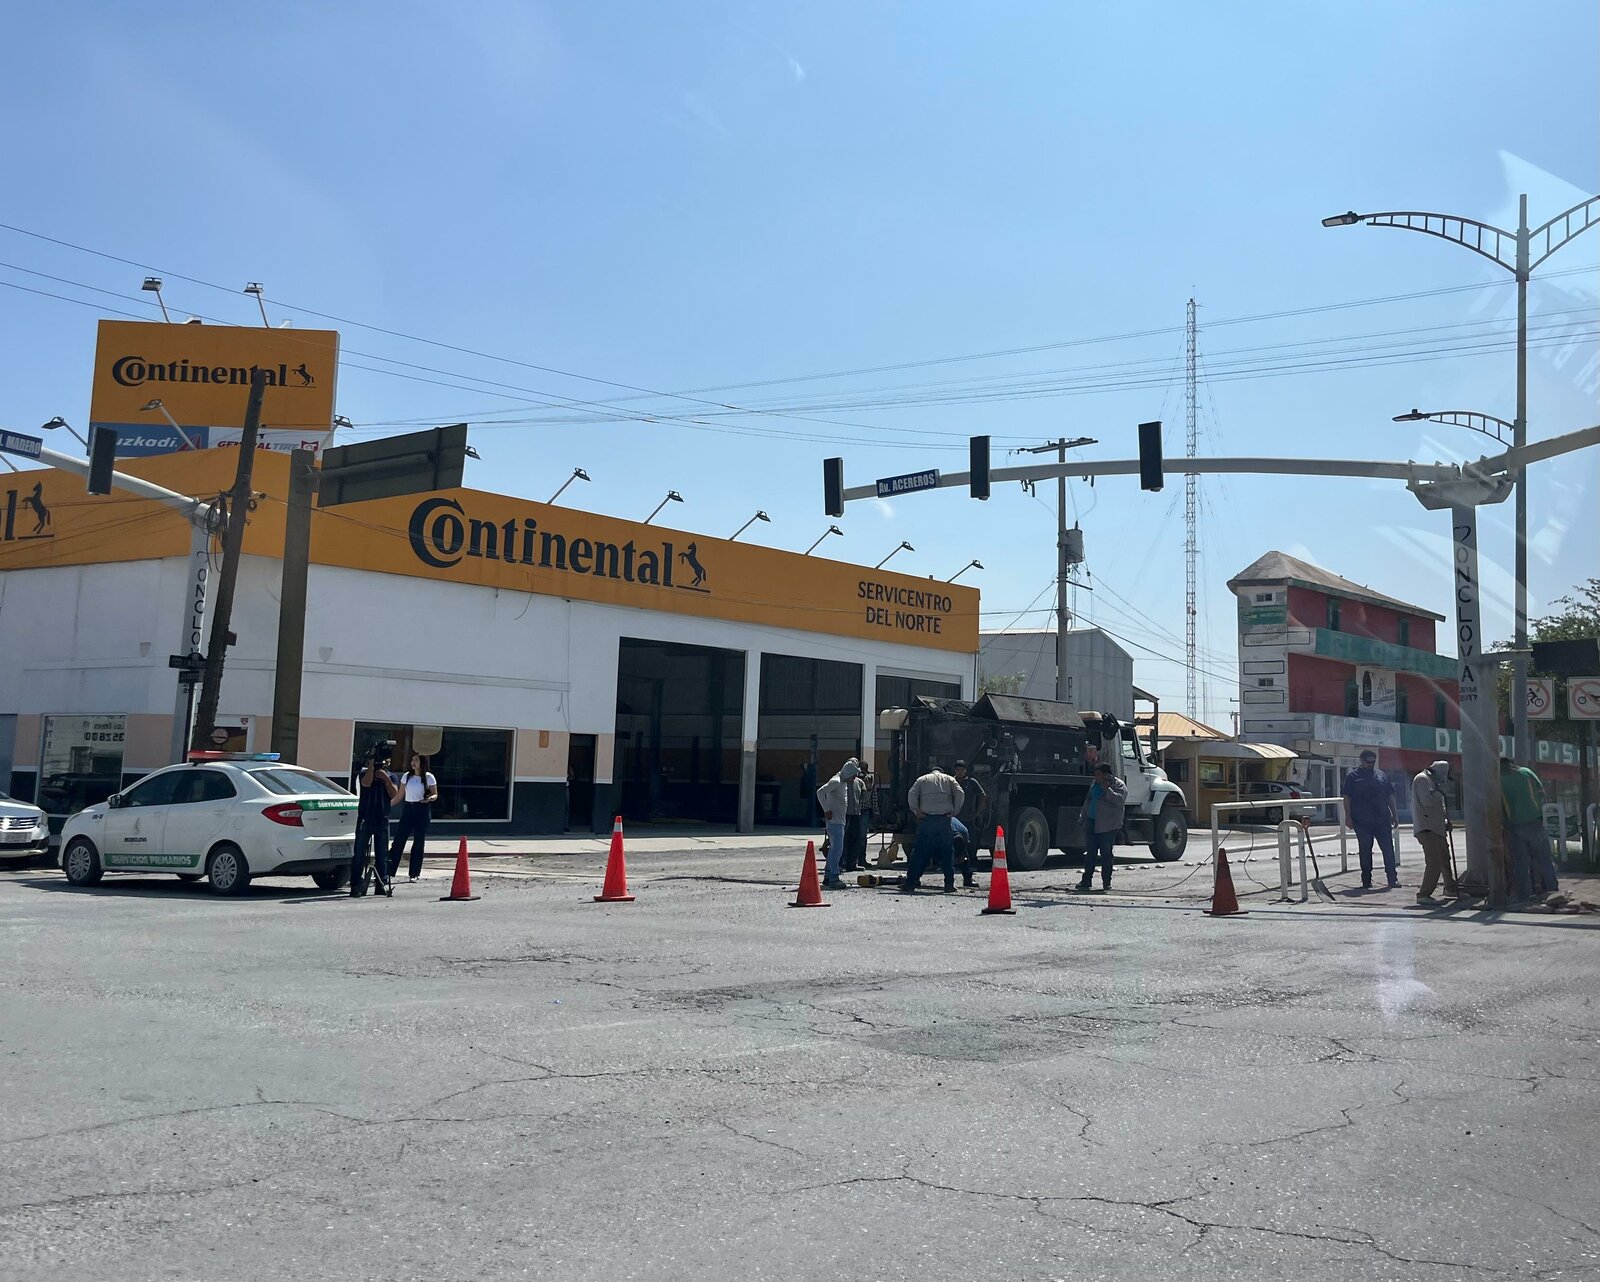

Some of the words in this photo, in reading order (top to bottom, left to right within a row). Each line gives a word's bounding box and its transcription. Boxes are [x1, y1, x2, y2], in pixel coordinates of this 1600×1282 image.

[5, 435, 41, 455] MADERO
[892, 473, 935, 492] ACEREROS
[409, 498, 673, 587] Continental
[858, 581, 952, 613] SERVICENTRO
[866, 606, 892, 627] DEL
[895, 611, 942, 634] NORTE
[111, 855, 148, 865] SERVICIOS
[149, 855, 191, 865] PRIMARIOS
